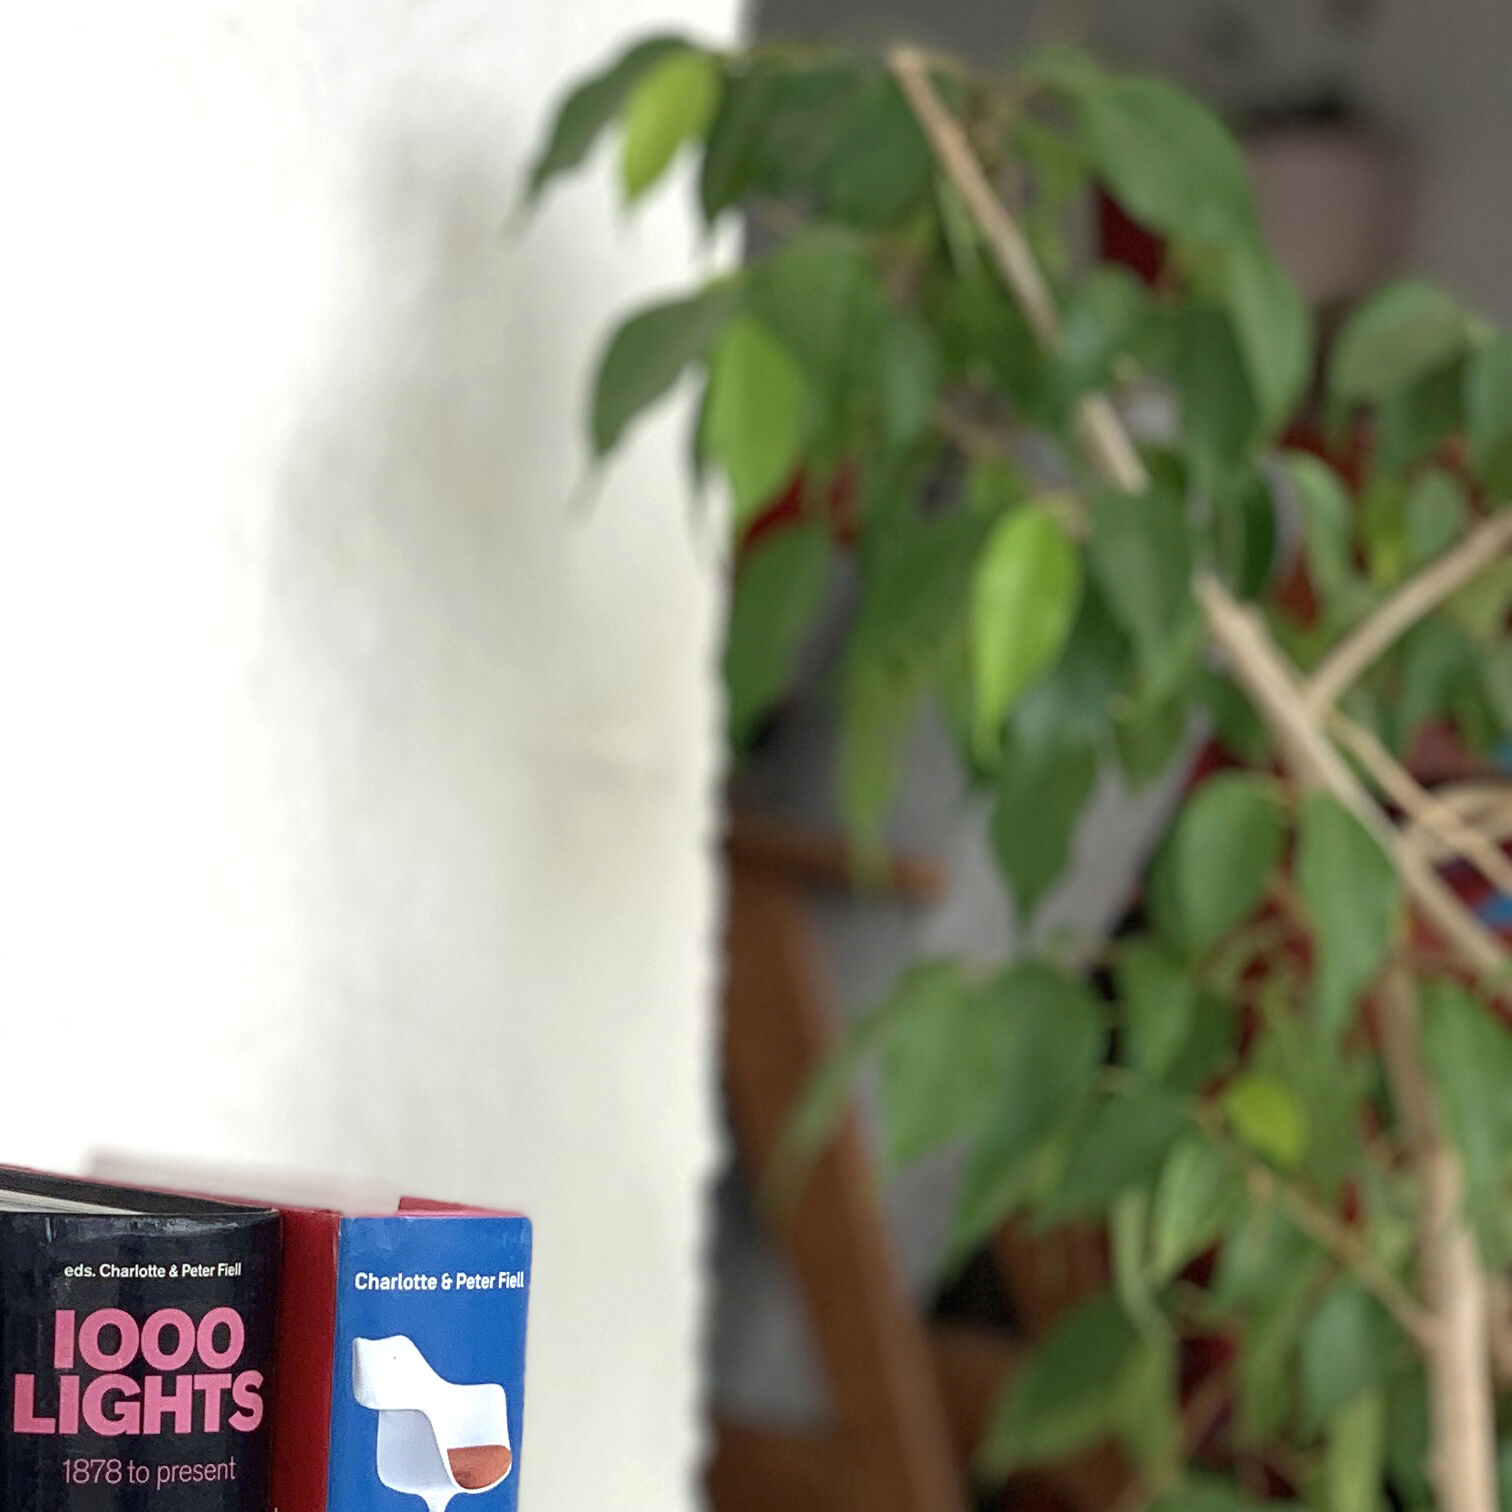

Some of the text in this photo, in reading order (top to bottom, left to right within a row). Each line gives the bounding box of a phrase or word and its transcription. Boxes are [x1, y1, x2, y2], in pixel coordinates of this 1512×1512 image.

[64, 1263, 241, 1277] eds. Charlotte & Peter Fiell
[355, 1271, 524, 1290] Charlotte & Peter Fiell
[54, 1307, 244, 1371] 1000
[14, 1371, 263, 1436] LIGHTS
[63, 1457, 236, 1490] 1878 to present
